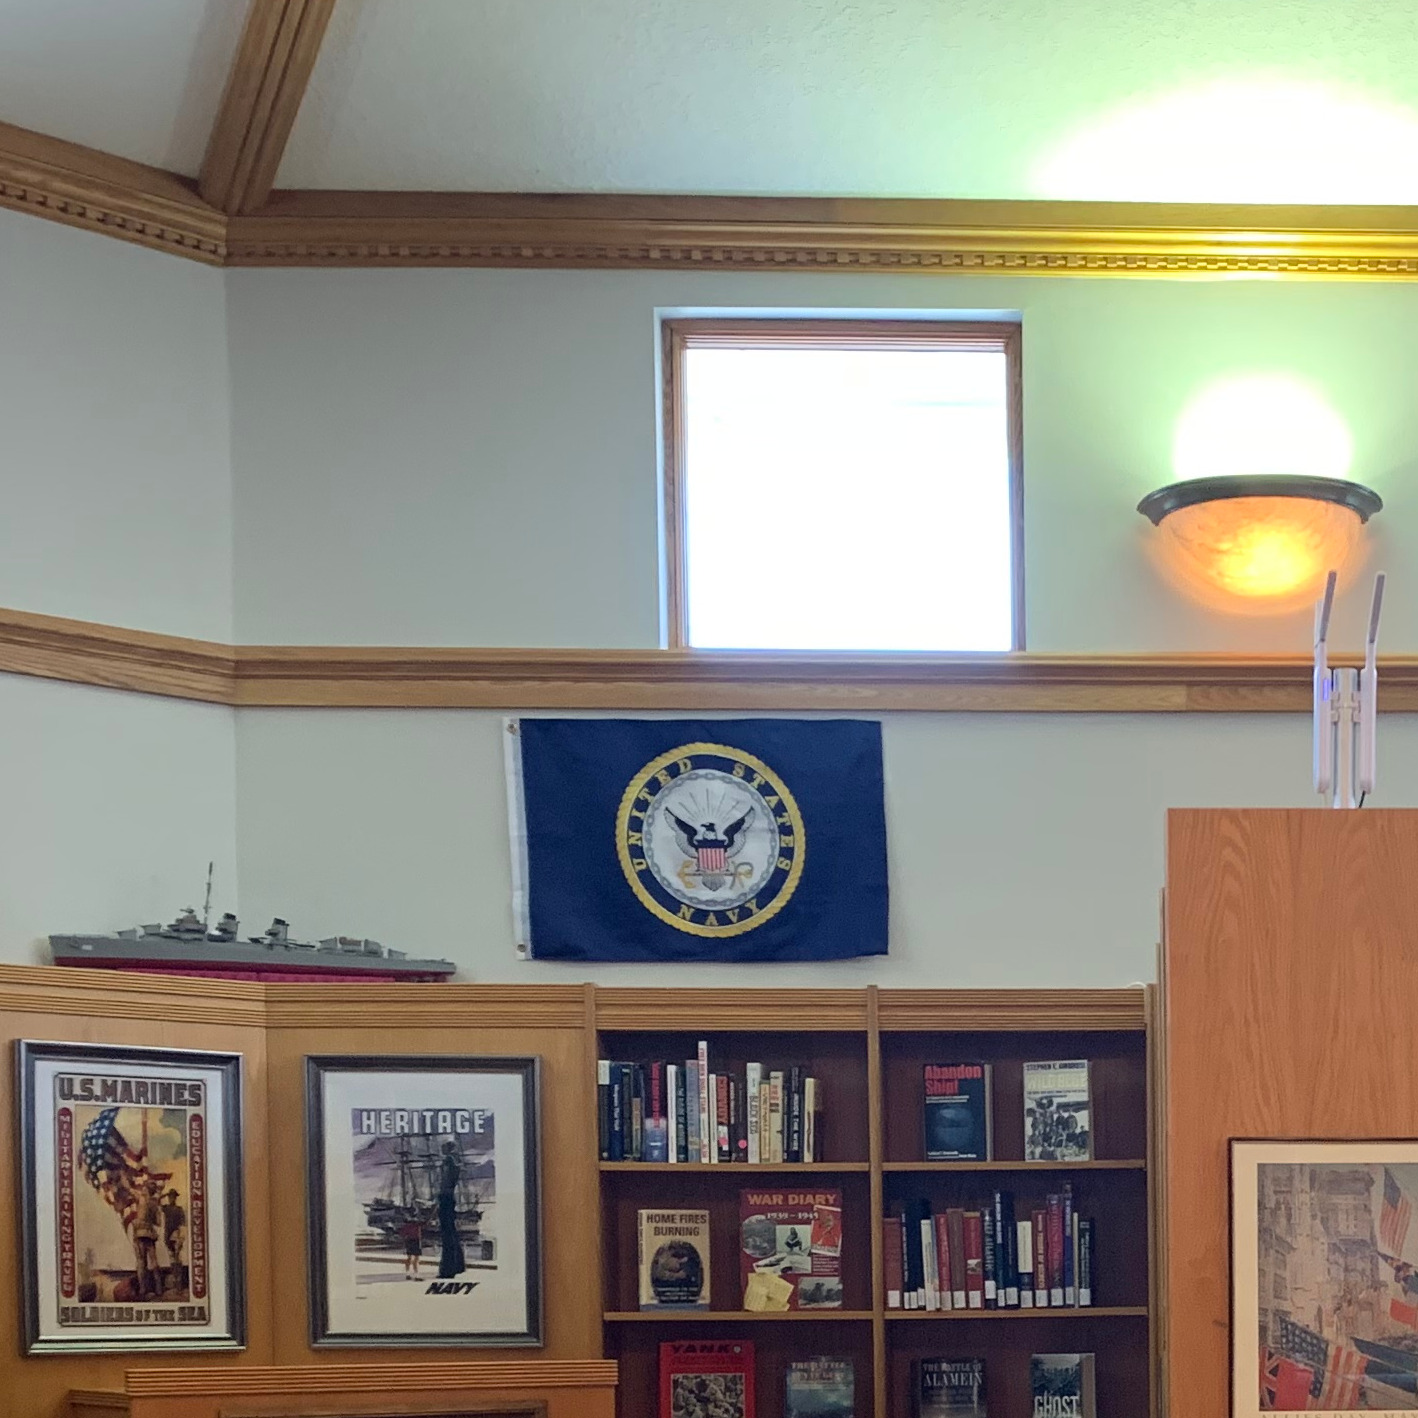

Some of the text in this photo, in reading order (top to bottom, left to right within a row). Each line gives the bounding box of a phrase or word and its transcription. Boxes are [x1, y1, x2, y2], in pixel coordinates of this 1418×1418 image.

[627, 758, 794, 873] UNITED STATES
[677, 897, 760, 926] NAVY
[925, 1064, 982, 1079] Abandon
[58, 1077, 201, 1107] U.S. MARINES
[361, 1110, 485, 1134] HERITAGE
[747, 1194, 837, 1206] WAR DIARY
[646, 1213, 707, 1225] HOME FIRES
[654, 1226, 700, 1237] BURNING
[425, 1282, 480, 1295] NAVY
[671, 1344, 730, 1355] YANK
[923, 1372, 983, 1387] ALAMEIN
[1034, 1391, 1080, 1416] GHOST
